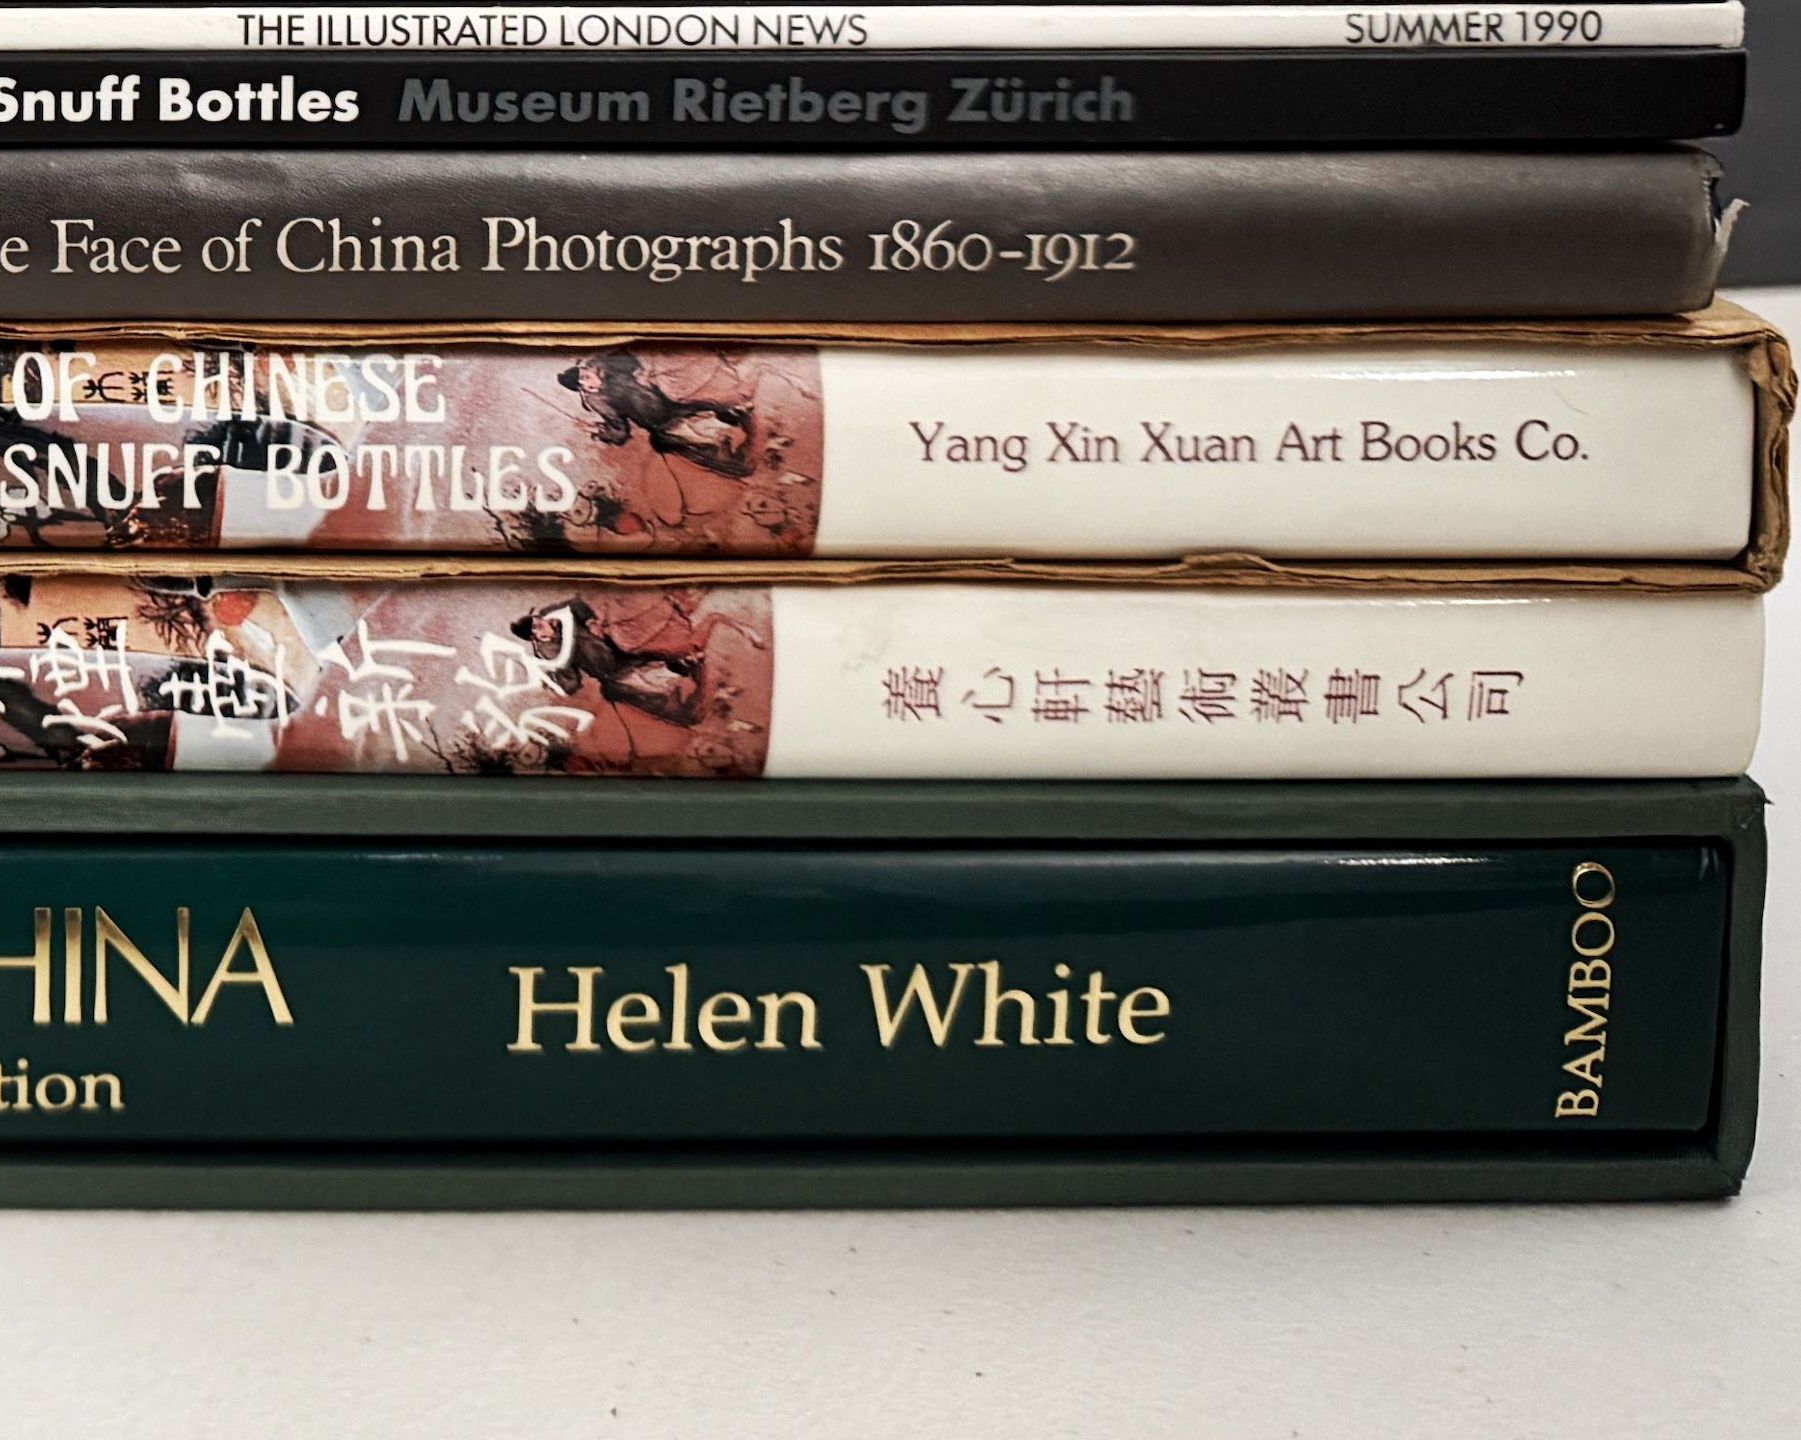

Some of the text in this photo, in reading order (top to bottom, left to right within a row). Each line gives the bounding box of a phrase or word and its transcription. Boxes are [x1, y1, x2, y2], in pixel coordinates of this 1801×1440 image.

[237, 10, 870, 48] THE ILLUSTRATED LONDON NEWS
[1344, 9, 1604, 45] SUMMER 1990
[158, 73, 361, 124] Bottles
[397, 75, 1135, 135] Museum Rietberg Zürich
[50, 218, 182, 275] Face
[201, 217, 264, 273] of
[276, 216, 462, 274] China
[480, 216, 845, 284] Photographs
[12, 350, 98, 422] OF
[146, 350, 447, 424] CHINESE
[909, 418, 1590, 474] Yang Xin Xuan Art Books Co.
[265, 444, 581, 514] BOTTLES
[506, 959, 1171, 1053] Helen White
[1554, 860, 1617, 1119] BAMBOO
